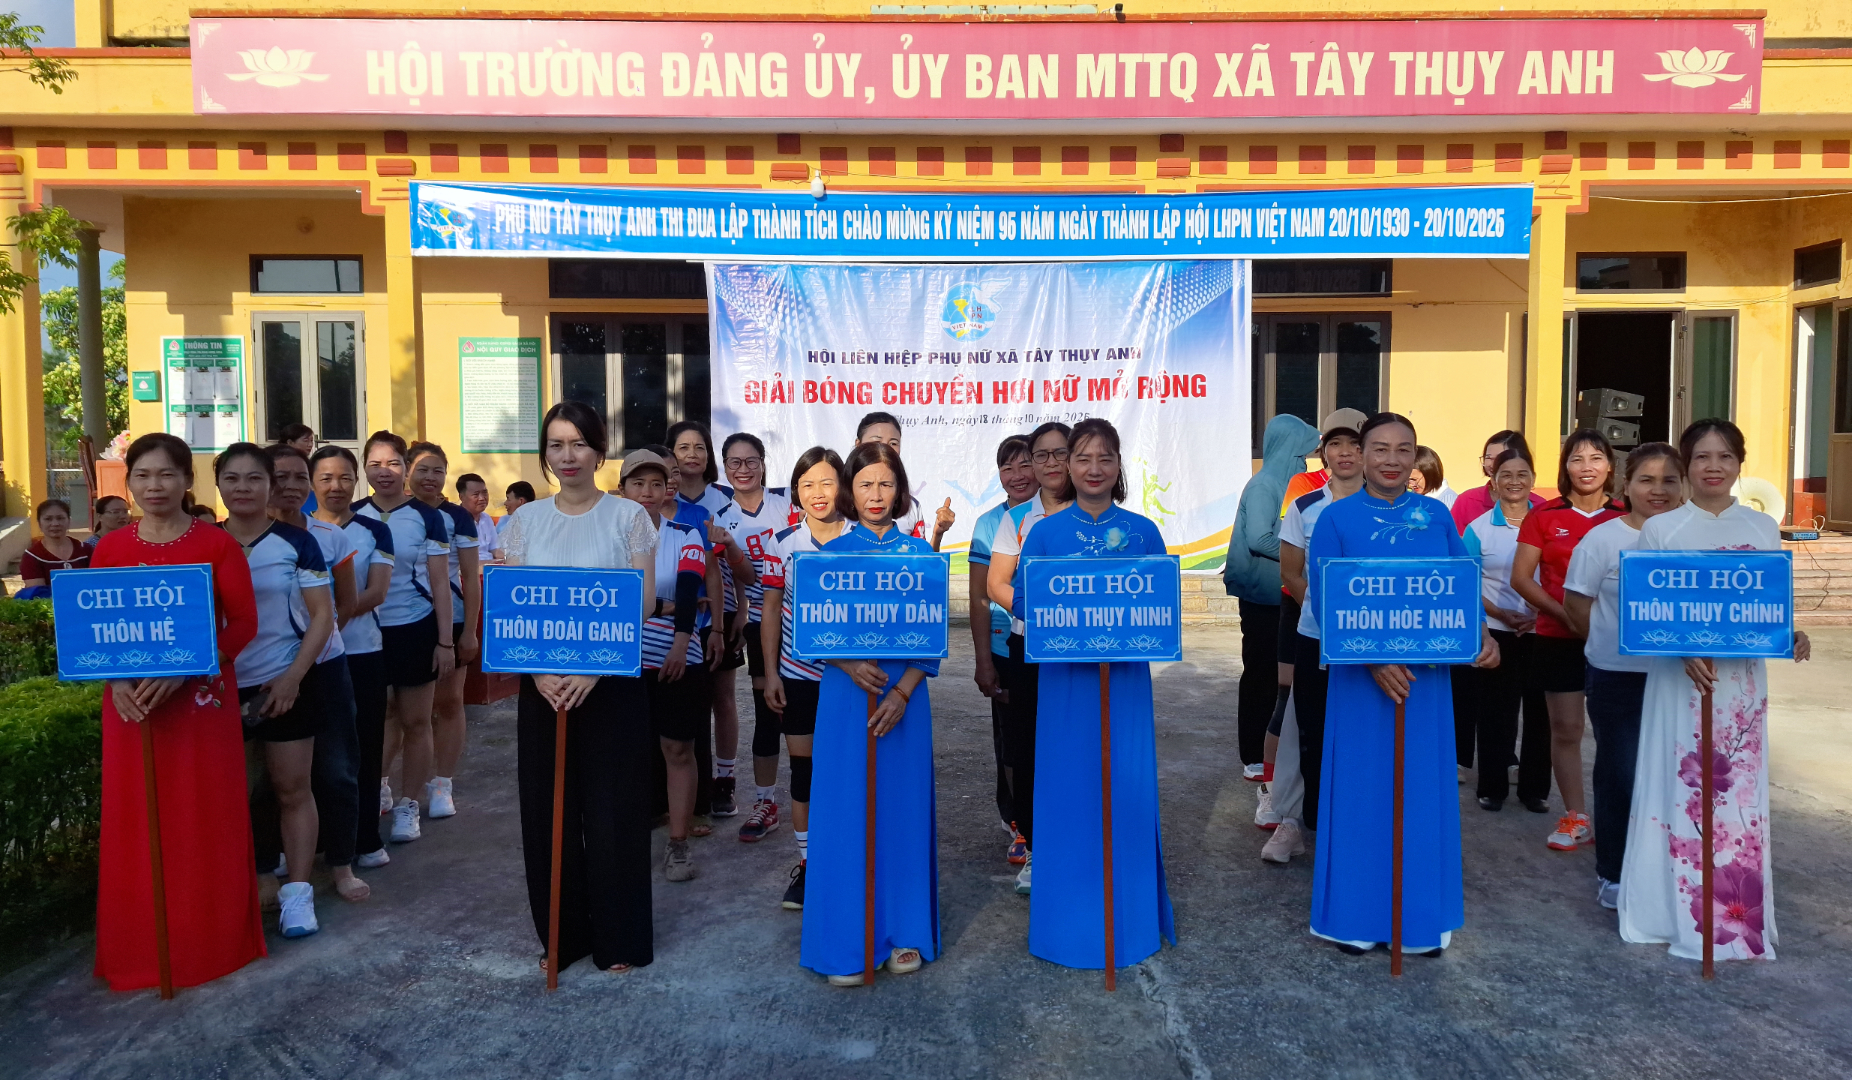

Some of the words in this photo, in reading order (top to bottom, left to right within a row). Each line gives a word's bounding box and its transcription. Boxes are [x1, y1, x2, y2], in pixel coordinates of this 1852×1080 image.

[366, 40, 444, 106] HỘI
[461, 39, 646, 98] TRƯỜNG
[660, 32, 788, 98] ĐẢNG
[804, 32, 876, 104] ỦY,
[892, 33, 950, 98] ỦY
[965, 53, 1060, 98] BAN
[1076, 52, 1199, 103] MTTQ
[1212, 43, 1276, 97] XÃ
[1290, 41, 1375, 96] TÂY
[1389, 49, 1506, 106] THỤY
[1517, 49, 1615, 95] ANH
[555, 198, 580, 235] TÂY
[586, 205, 622, 243] THỤY
[626, 206, 656, 238] ANH
[660, 206, 681, 238] THI
[687, 207, 717, 239] ĐUA
[719, 201, 748, 245] LẬP
[752, 203, 800, 240] THÀNH
[804, 203, 838, 240] TÍCH
[843, 203, 881, 241] CHÀO
[886, 203, 931, 241] MỪNG
[934, 203, 954, 241] KỶ
[956, 204, 995, 247] NIỆM
[999, 210, 1017, 241] 95
[1020, 204, 1055, 241] NĂM
[1059, 203, 1099, 240] NGÀY
[1102, 203, 1150, 240] THÀNH
[1153, 203, 1181, 246] LẬP
[1185, 203, 1210, 245] HỘI
[1213, 208, 1253, 239] LHPN
[1256, 202, 1286, 245] VIỆT
[1289, 208, 1325, 239] NAM
[1329, 207, 1410, 238] 20/10/1930
[1414, 220, 1420, 228] -
[1423, 207, 1505, 238] 20/10/2025
[808, 348, 836, 367] HỘI
[841, 349, 879, 365] LIÊN
[884, 349, 923, 367] HIỆP
[927, 351, 962, 367] PHỤ
[967, 349, 993, 364] NỮ
[996, 349, 1019, 364] XÃ
[1025, 347, 1053, 362] TÂY
[1059, 348, 1101, 365] THỤY
[1106, 346, 1142, 360] ANH
[744, 371, 795, 405] GIẢI
[803, 375, 873, 405] BÓNG
[882, 373, 983, 405] CHUYỀN
[992, 377, 1034, 404] HƠI
[1043, 373, 1081, 403] NỮ
[1087, 368, 1129, 402] MỞ
[1137, 369, 1207, 404] RỘNG
[745, 528, 774, 560] 87
[819, 571, 866, 591] CHI
[875, 565, 925, 596] HỘI
[1048, 574, 1096, 595] CHI
[1104, 567, 1155, 599] HỘI
[1348, 576, 1397, 596] CHI
[1404, 569, 1456, 600] HỘI
[1648, 569, 1700, 588] CHI
[1709, 563, 1765, 595] HỘI
[76, 588, 126, 610] CHI
[133, 579, 186, 612] HỘI
[511, 585, 559, 606] CHI
[567, 581, 619, 613] HỘI
[800, 598, 848, 623] THÔN
[854, 603, 900, 628] THỤY
[905, 599, 943, 623] DÂN
[1033, 603, 1078, 628] THÔN
[1082, 606, 1125, 632] THỤY
[1130, 606, 1172, 627] NINH
[1335, 605, 1384, 630] THÔN
[1389, 604, 1423, 630] HÒE
[1428, 608, 1467, 629] NHA
[1628, 597, 1675, 621] THÔN
[1679, 602, 1724, 626] THỤY
[1729, 598, 1785, 623] CHÍNH
[91, 618, 145, 644] THÔN
[149, 616, 176, 646] HỆ
[492, 614, 538, 639] THÔN
[542, 616, 583, 641] ĐOÀI
[588, 621, 635, 643] GANG
